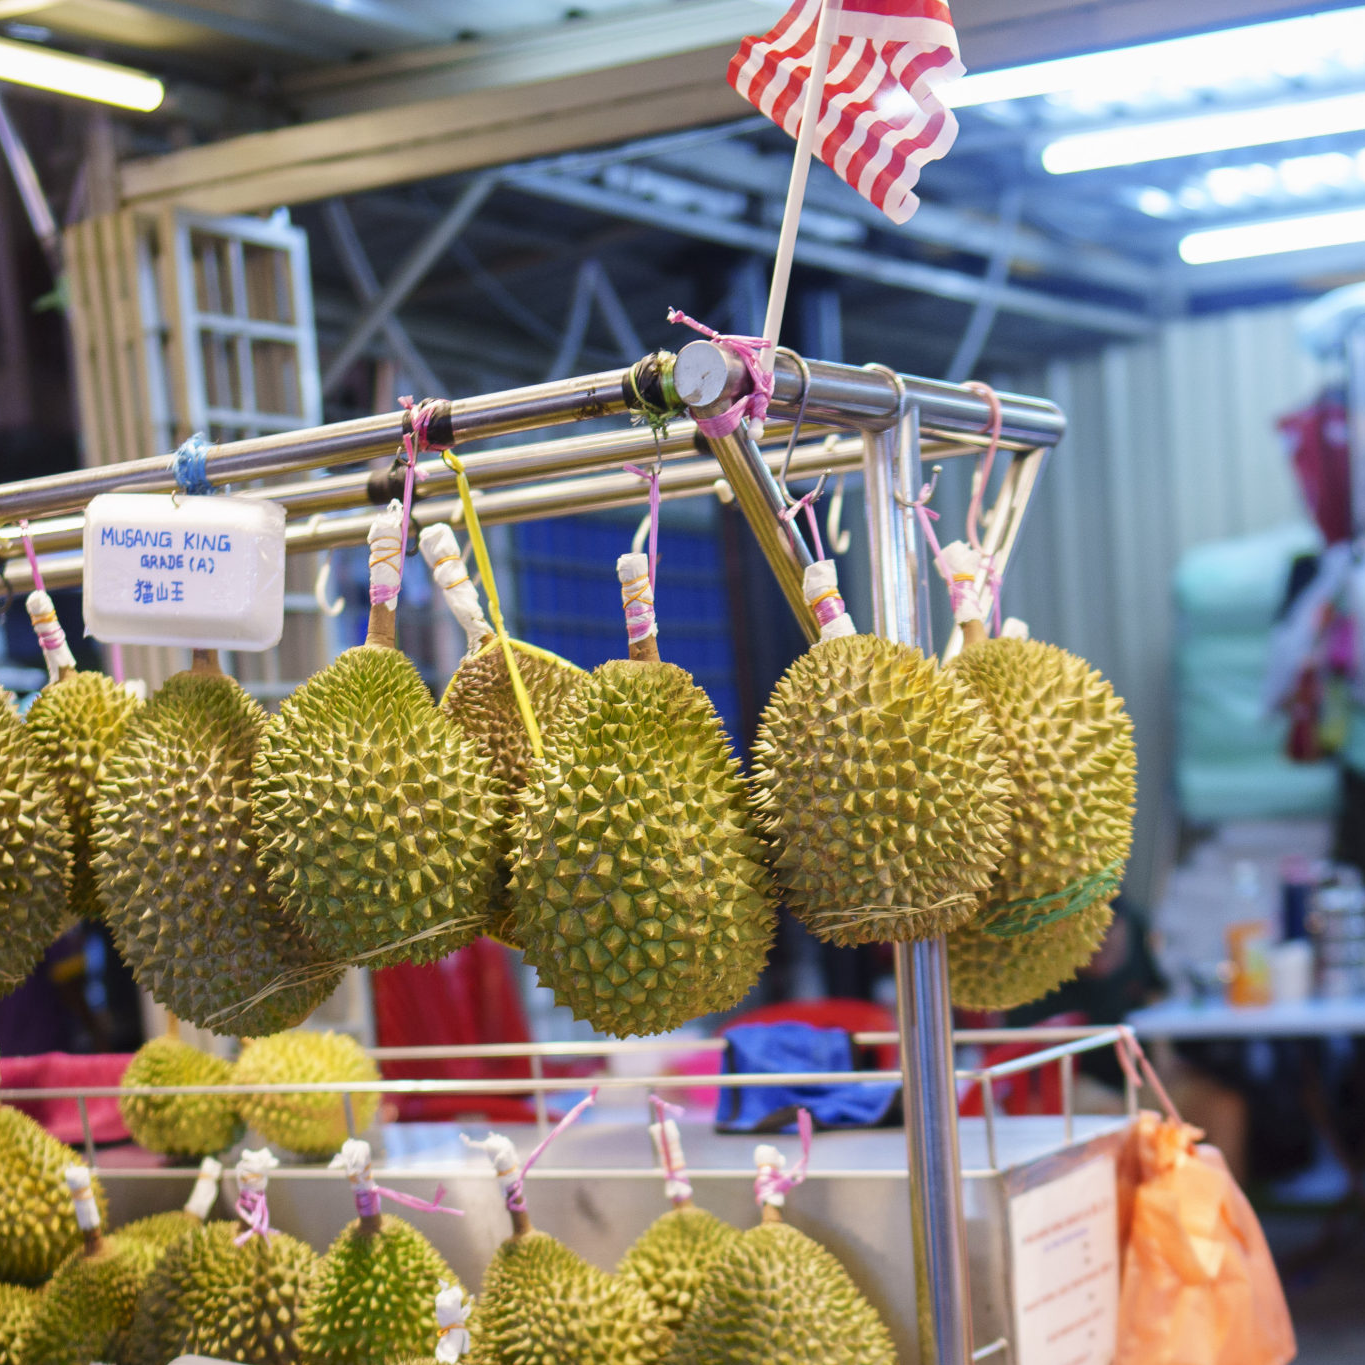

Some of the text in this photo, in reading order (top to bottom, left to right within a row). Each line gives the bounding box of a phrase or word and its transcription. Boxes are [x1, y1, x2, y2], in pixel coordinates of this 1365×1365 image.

[101, 527, 231, 552] MUSANG KING
[140, 554, 215, 574] GRADE (A)
